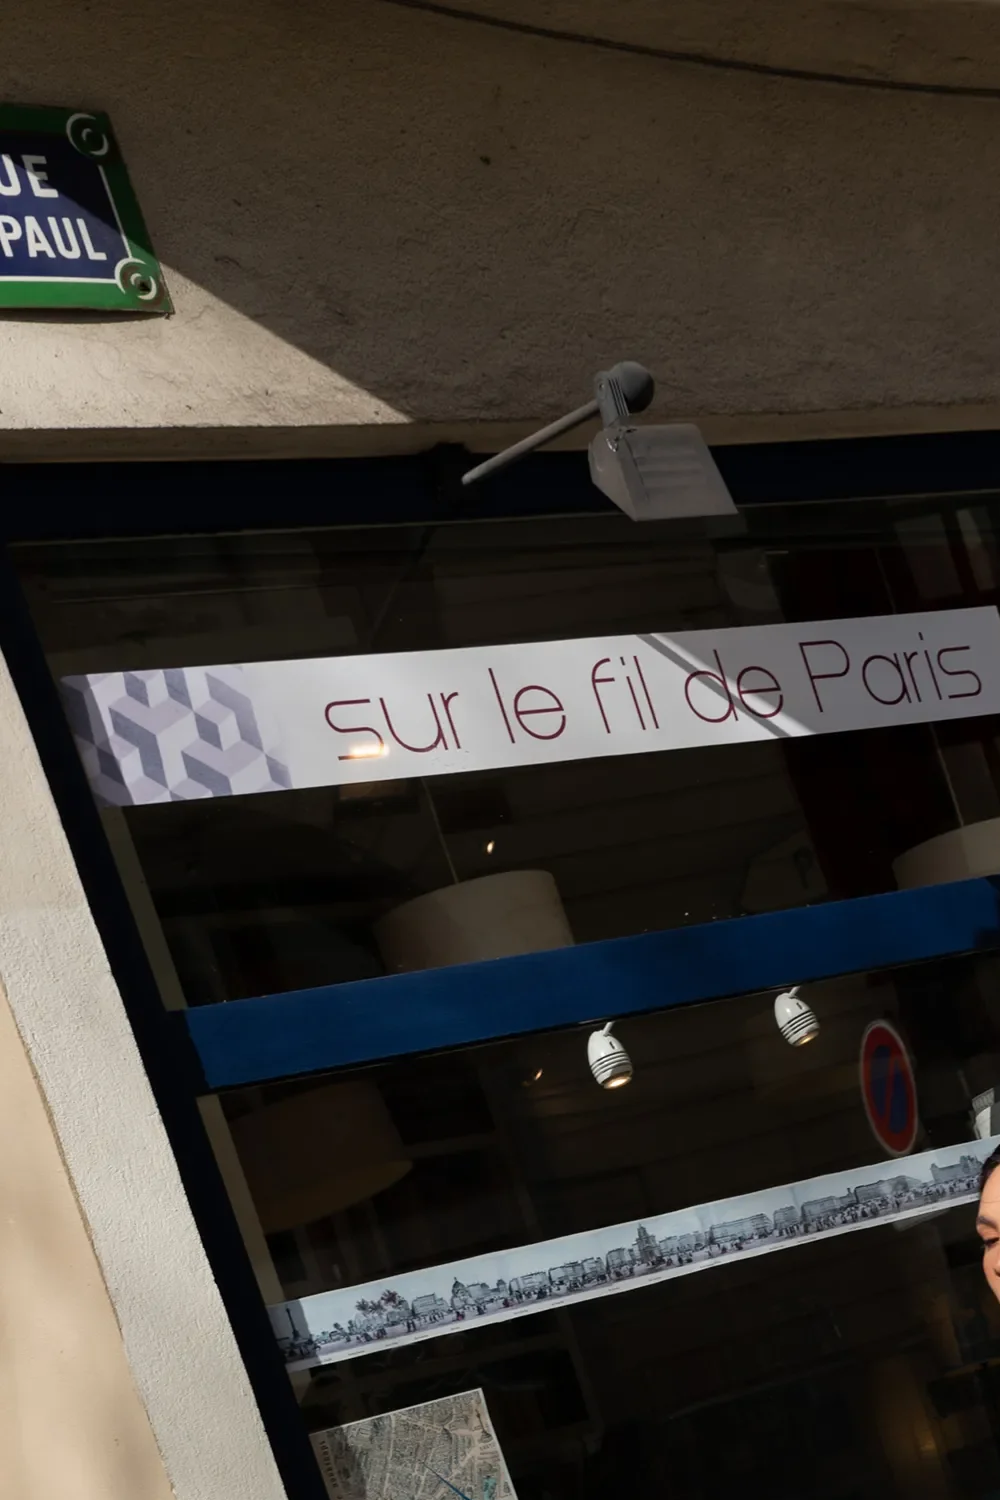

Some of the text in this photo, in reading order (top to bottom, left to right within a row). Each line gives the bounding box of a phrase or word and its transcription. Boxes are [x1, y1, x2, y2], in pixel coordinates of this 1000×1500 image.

[0, 215, 107, 260] PAUL
[325, 632, 982, 762] sur le fil de Paris
